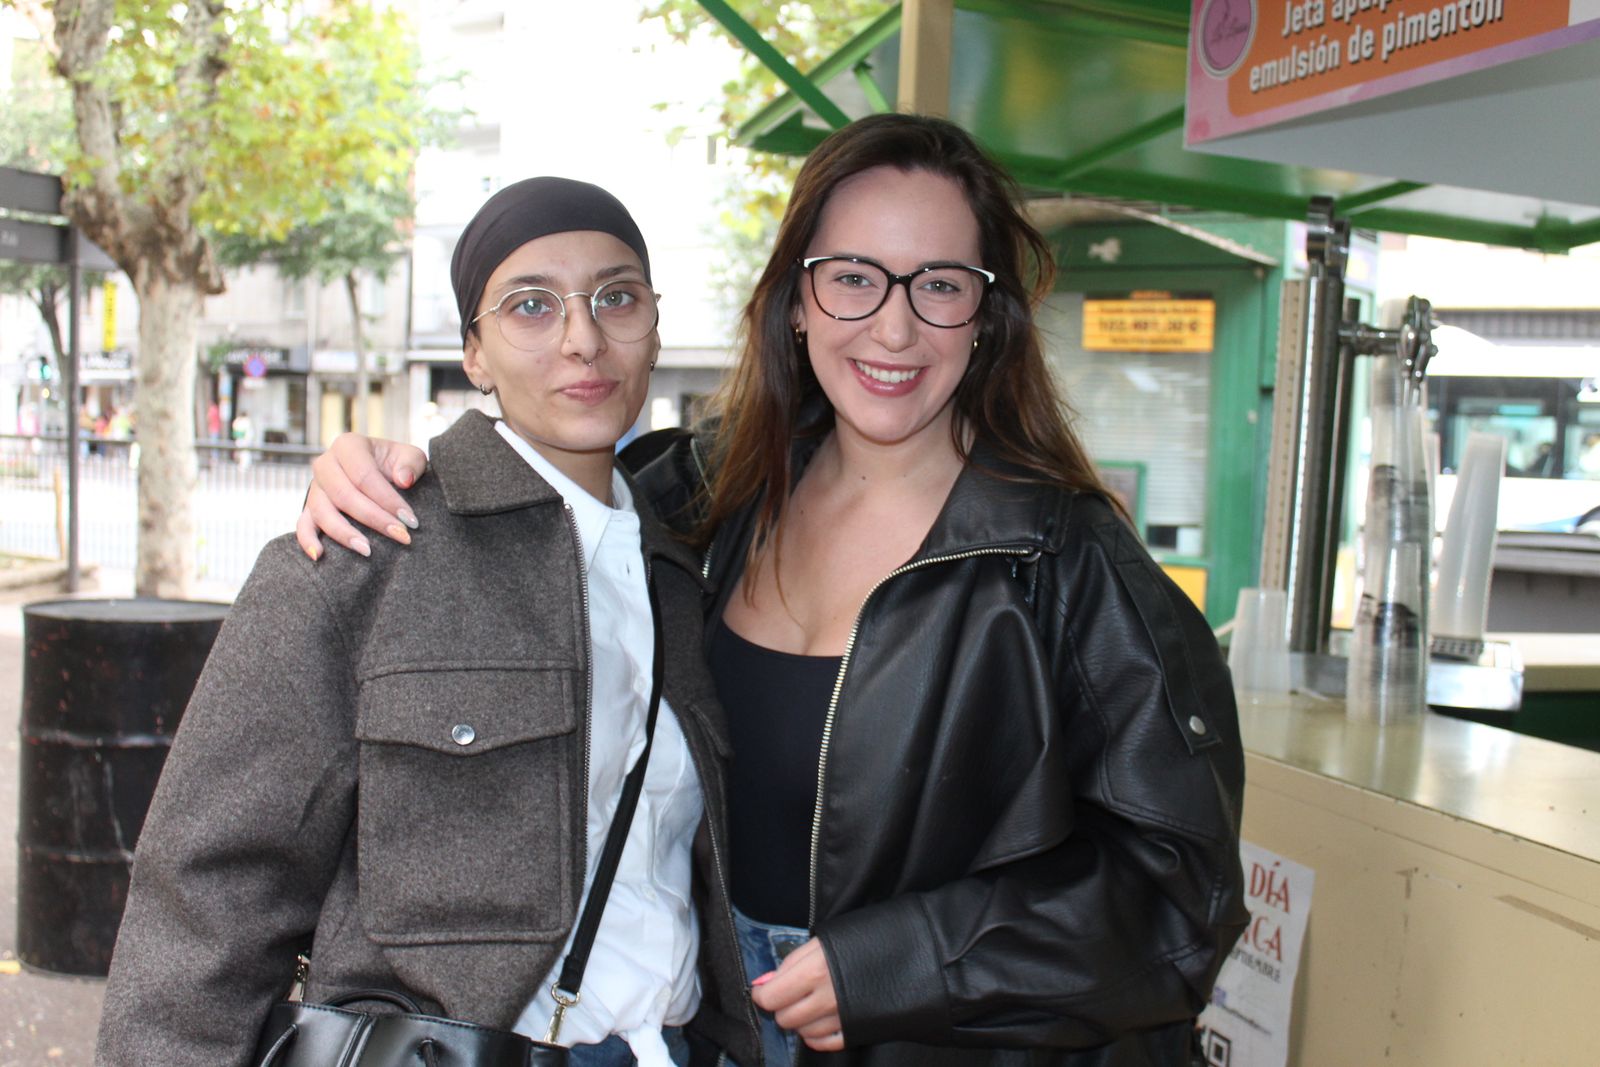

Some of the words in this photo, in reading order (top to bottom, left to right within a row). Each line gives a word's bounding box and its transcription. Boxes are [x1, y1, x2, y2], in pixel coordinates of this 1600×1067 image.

[1281, 0, 1326, 36] Jeta
[1249, 34, 1341, 93] emulsión
[1348, 24, 1376, 63] de
[1250, 861, 1291, 914] DÍA
